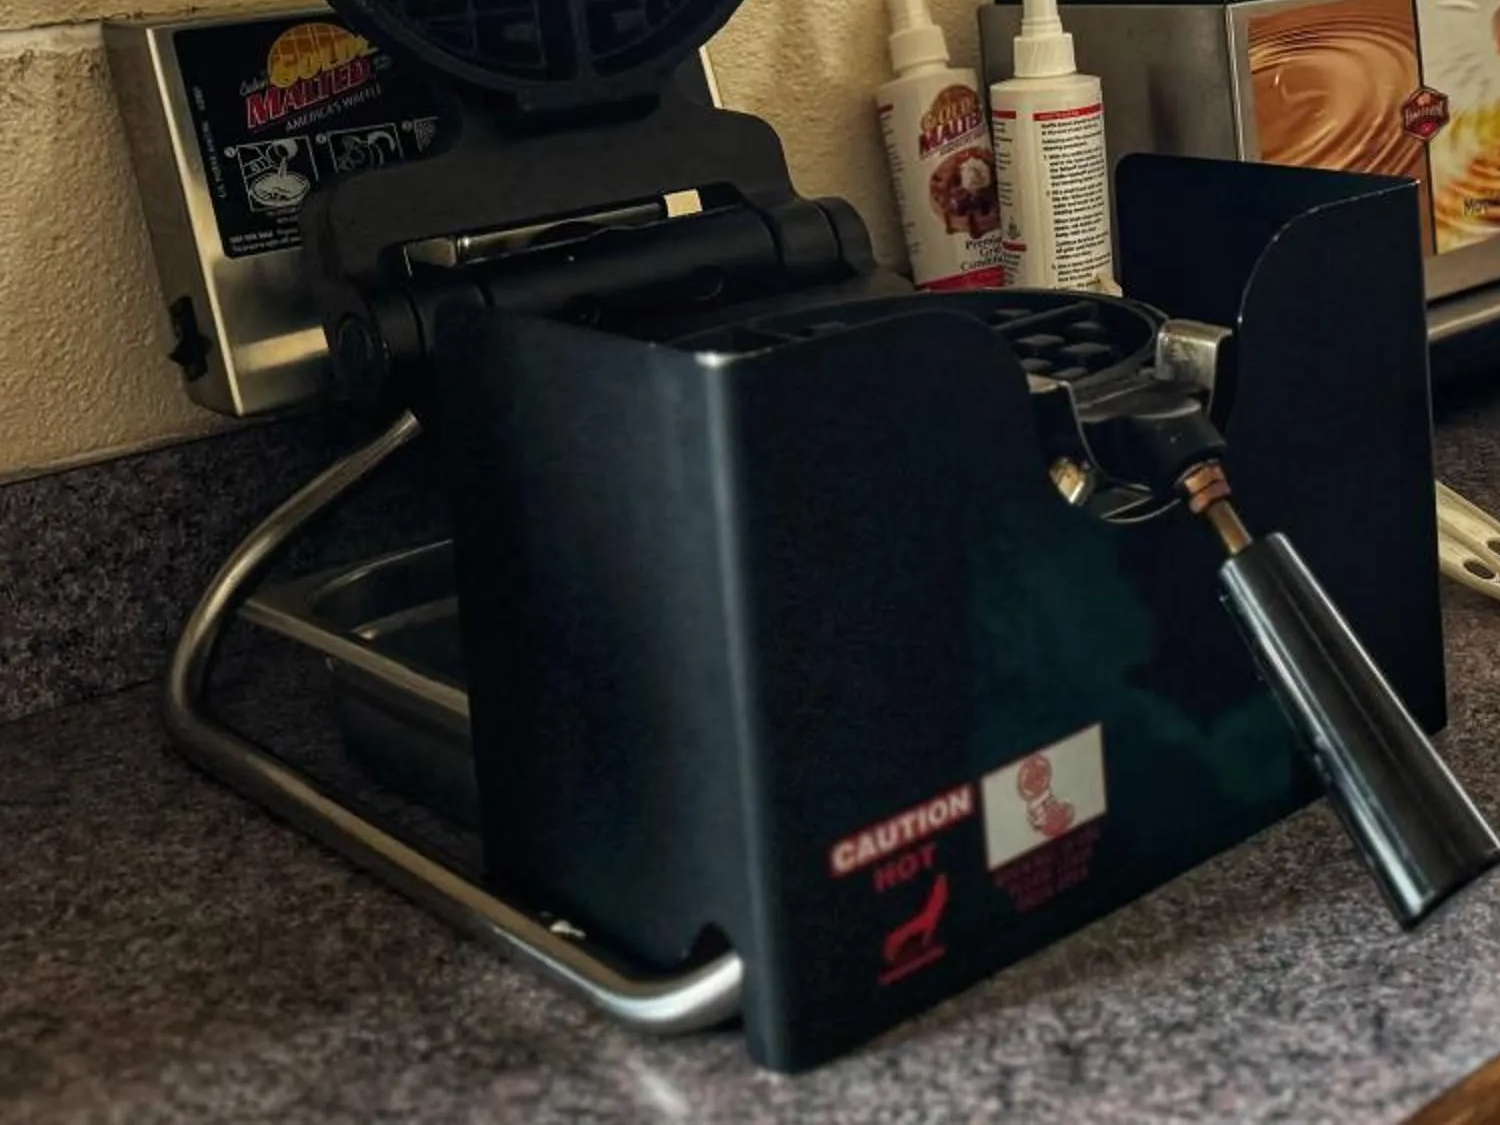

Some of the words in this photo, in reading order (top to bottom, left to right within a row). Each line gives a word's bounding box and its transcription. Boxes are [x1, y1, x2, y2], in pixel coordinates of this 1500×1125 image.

[246, 56, 372, 131] MALTED
[831, 781, 975, 875] CAUTION
[872, 842, 938, 892] HOT
